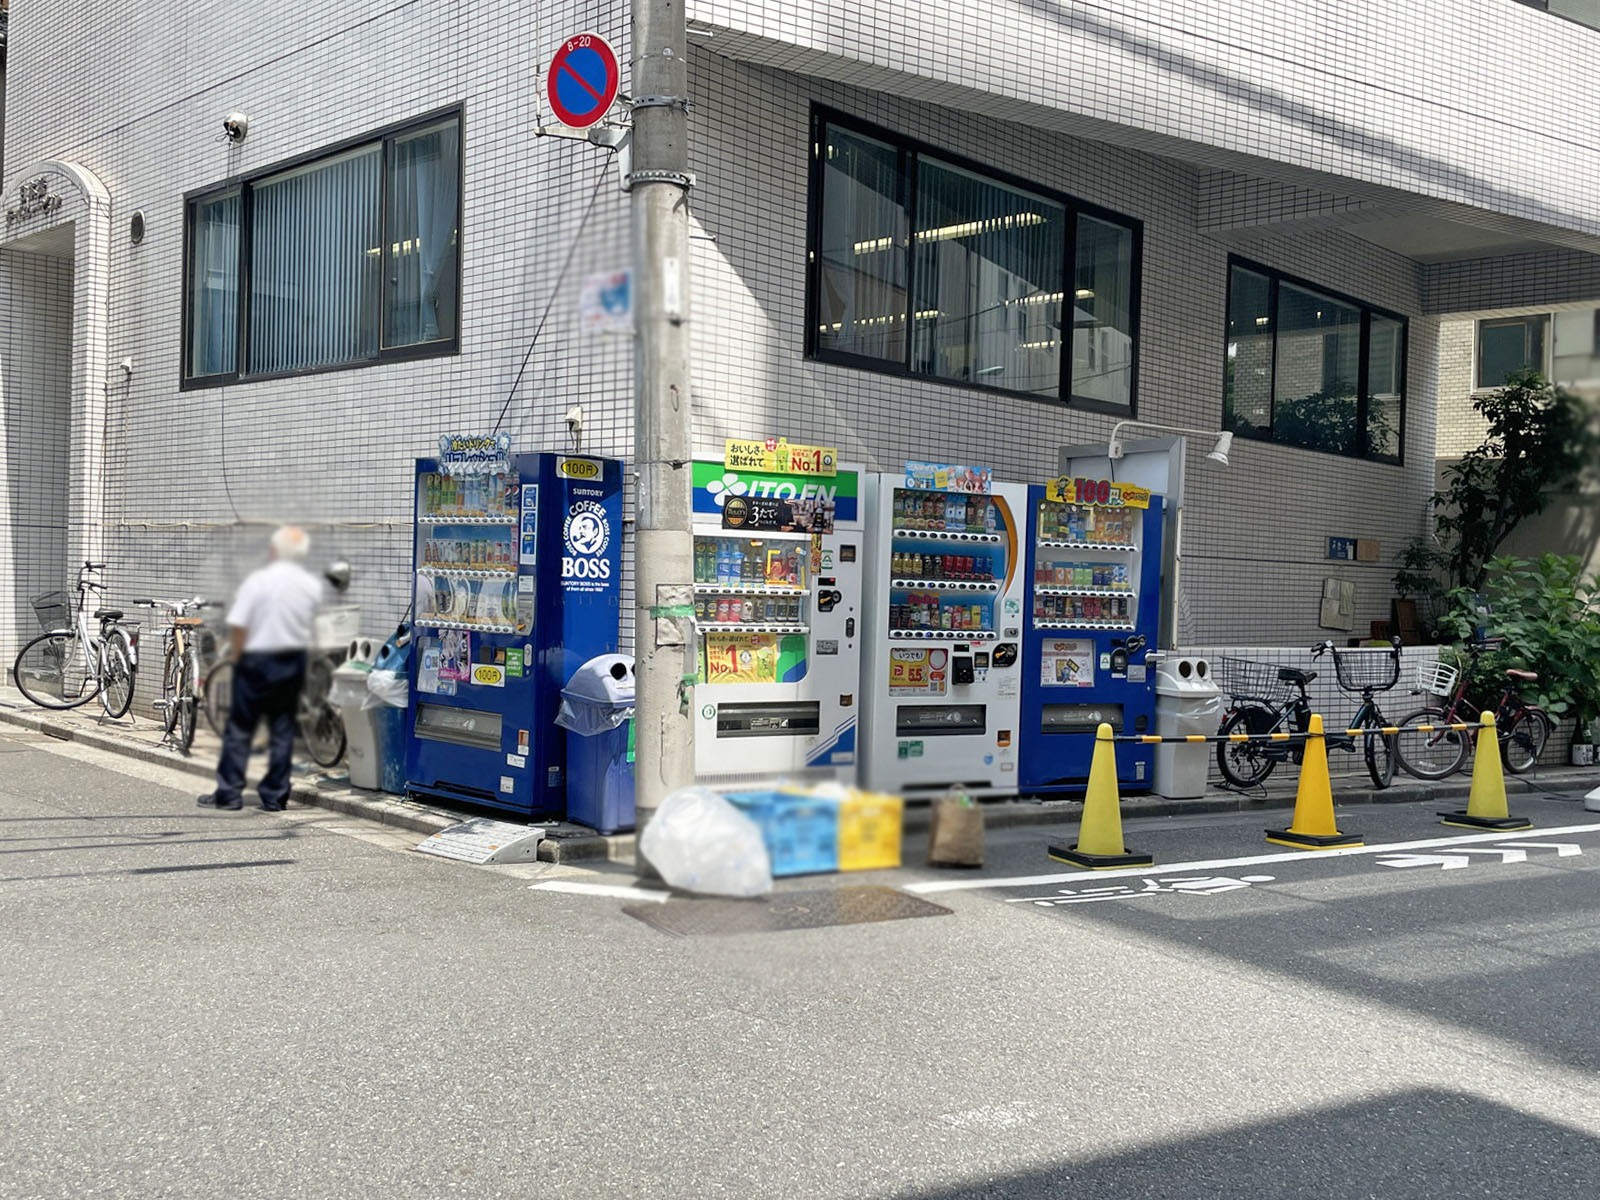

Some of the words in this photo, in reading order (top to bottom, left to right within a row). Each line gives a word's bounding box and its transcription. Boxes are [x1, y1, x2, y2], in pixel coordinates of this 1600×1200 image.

[567, 36, 591, 52] 8-20
[730, 443, 765, 456] おいしさで
[566, 462, 593, 475] 100円
[791, 449, 822, 473] No.1
[569, 500, 607, 519] COFFEE
[561, 557, 610, 579] BOSS
[478, 669, 498, 681] 100円
